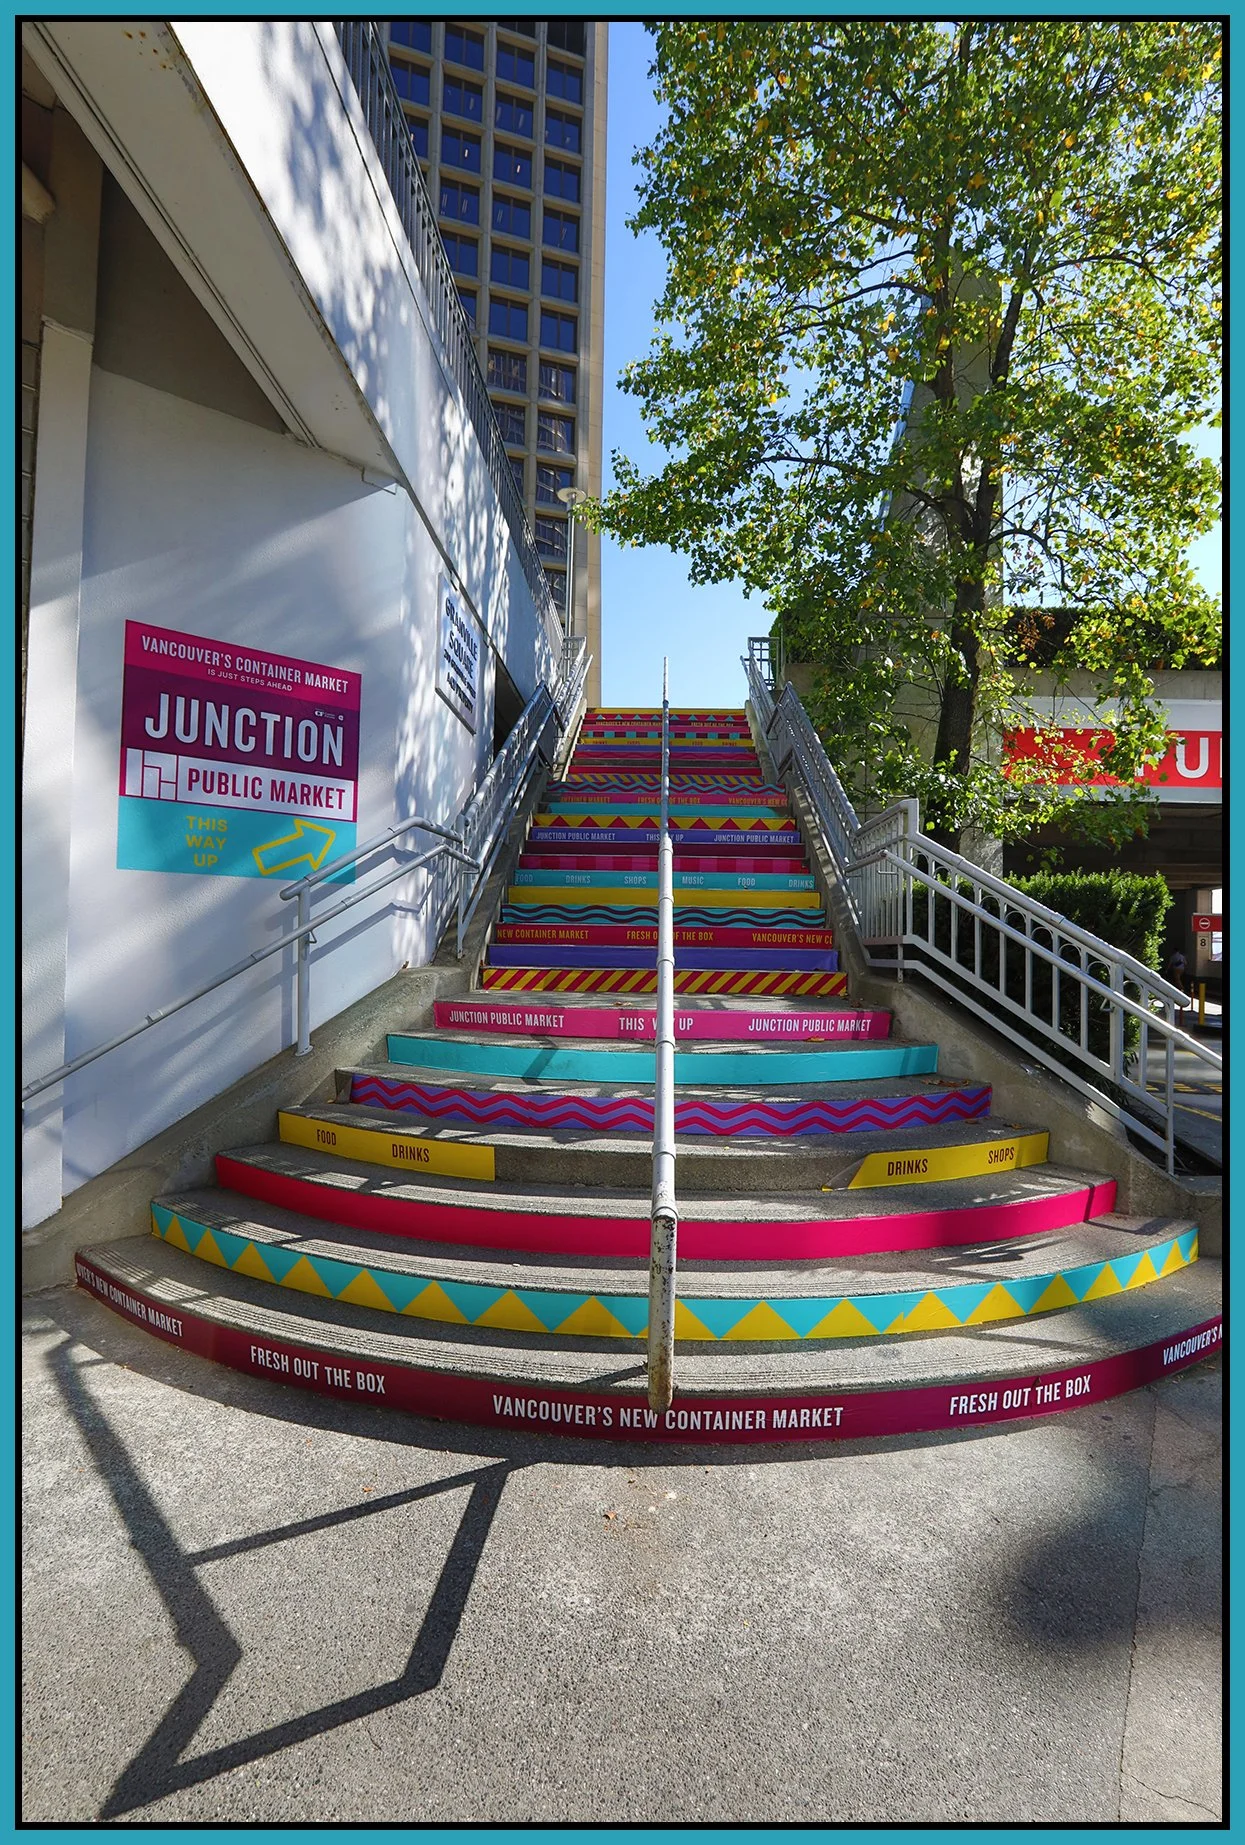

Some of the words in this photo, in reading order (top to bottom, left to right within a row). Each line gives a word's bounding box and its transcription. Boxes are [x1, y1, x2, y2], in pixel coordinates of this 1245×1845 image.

[141, 635, 232, 669] VANCOUVER'S
[236, 656, 301, 684] CONTAINER
[304, 671, 349, 694] MARKET
[207, 668, 216, 676] IS
[218, 671, 238, 680] JUST
[240, 675, 265, 686] STEPS
[266, 680, 293, 692] AHEAD
[145, 692, 344, 767] JUNCTION
[187, 767, 263, 801] PUBLIC
[270, 777, 346, 810] MARKET
[186, 815, 228, 833] THIS
[186, 834, 227, 850] WAY
[536, 831, 566, 840] JUNCTION
[567, 832, 590, 841] PUBLIC
[591, 832, 616, 841] MARKET
[646, 833, 660, 841] THIS
[675, 834, 684, 842] UP
[713, 834, 745, 842] JUNCTION
[746, 834, 769, 843] PUBLIC
[769, 835, 795, 843] MARKET
[193, 853, 219, 868] UP
[516, 874, 533, 883] FOOD
[565, 875, 591, 884] DRINKS
[623, 875, 647, 885] SHOPS
[682, 876, 705, 885] MUSIC
[737, 877, 756, 887] FOOD
[788, 879, 814, 888] DRINKS
[497, 929, 513, 939] NEW
[515, 929, 556, 939] CONTAINER
[558, 930, 589, 940] MARKET
[626, 930, 651, 940] FRESH
[682, 931, 696, 941] THE
[698, 931, 714, 941] BOX
[752, 932, 804, 944] VANCOUVER'S
[806, 933, 822, 944] NEW
[1199, 938, 1207, 947] 8
[449, 1010, 489, 1025] JUNCTION
[490, 1011, 523, 1027] PUBLIC
[525, 1013, 564, 1028] MARKET
[619, 1017, 645, 1031] THIS
[679, 1017, 694, 1031] UP
[748, 1018, 800, 1033] JUNCTION
[802, 1018, 835, 1032] PUBLIC
[837, 1019, 872, 1032] MARKET
[316, 1128, 337, 1146] FOOD
[391, 1143, 430, 1163] DRINKS
[987, 1146, 1015, 1165] SHOPS
[887, 1158, 928, 1176] DRINKS
[95, 1274, 109, 1297] NEW
[109, 1284, 147, 1321] CONTAINER
[147, 1307, 183, 1337] MARKET
[1163, 1326, 1218, 1366] VANCOUVER'S
[250, 1345, 289, 1373] FRESH
[293, 1357, 319, 1380] OUT
[324, 1366, 352, 1388] THE
[356, 1371, 386, 1394] BOX
[950, 1392, 998, 1415] FRESH
[1002, 1388, 1032, 1409] OUT
[1035, 1382, 1061, 1405] THE
[1065, 1375, 1091, 1399] BOX
[492, 1394, 614, 1427] VANCOUVER'S
[620, 1408, 659, 1429] NEW
[665, 1409, 766, 1430] CONTAINER
[772, 1407, 844, 1429] MARKET
